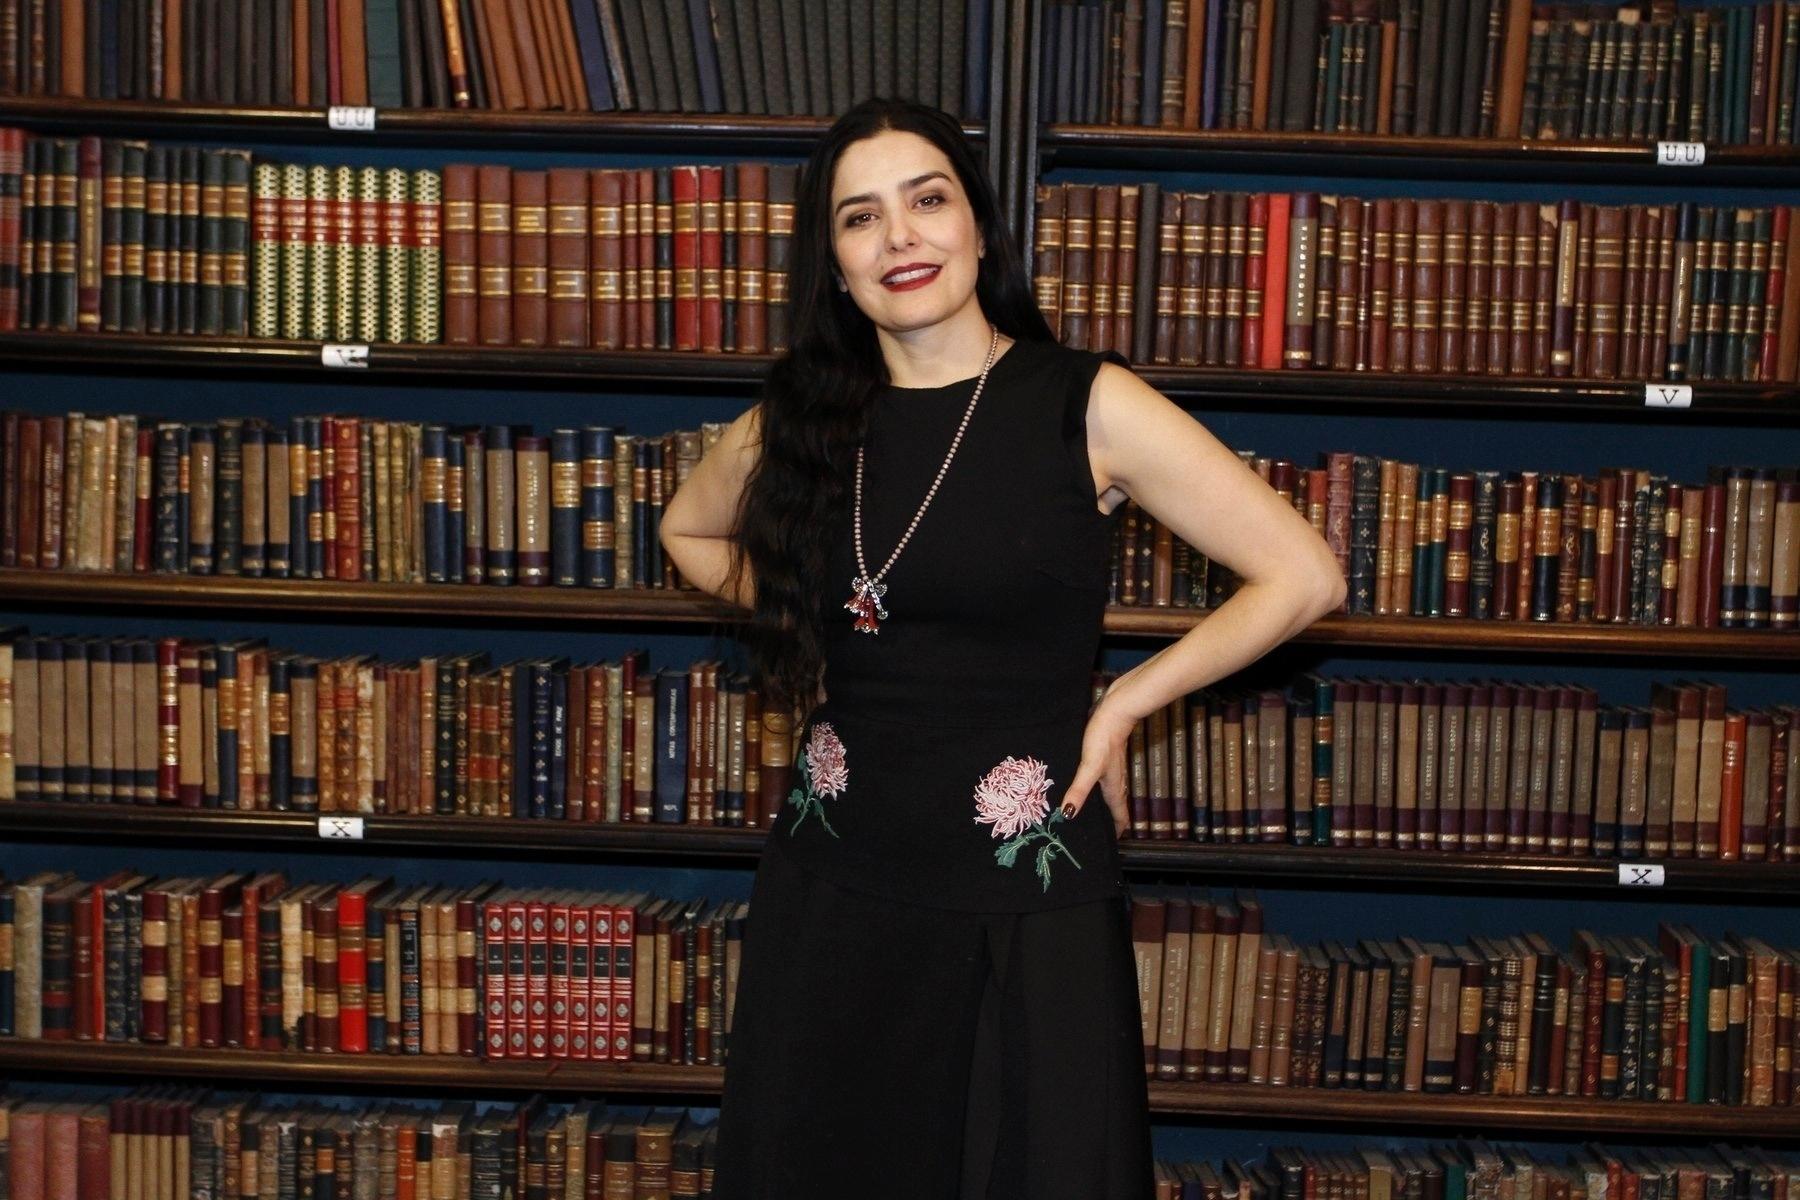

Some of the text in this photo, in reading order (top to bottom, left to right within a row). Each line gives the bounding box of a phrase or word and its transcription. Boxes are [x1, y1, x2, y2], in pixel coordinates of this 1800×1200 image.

[1666, 145, 1700, 162] U.U.
[1659, 388, 1679, 404] V
[1175, 765, 1183, 797] COLLECTION
[331, 821, 351, 837] X
[1631, 868, 1652, 884] X
